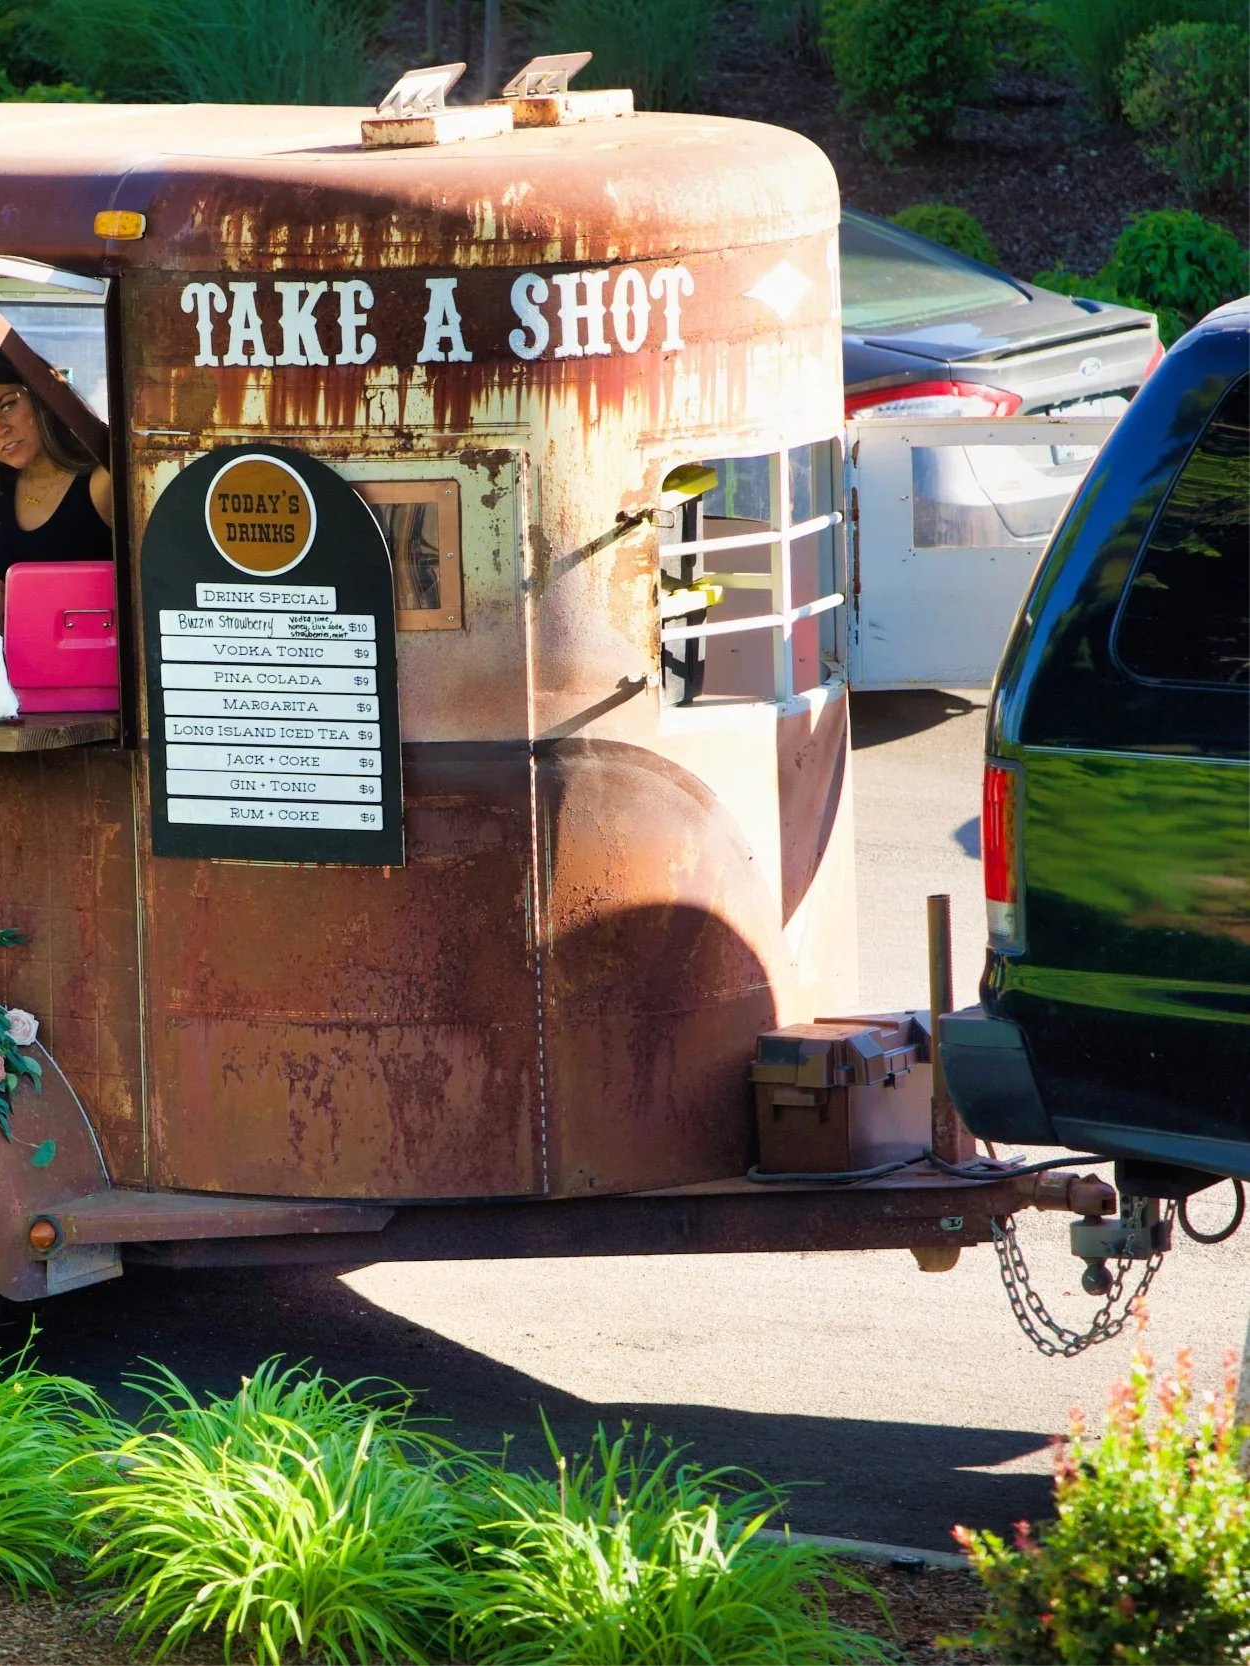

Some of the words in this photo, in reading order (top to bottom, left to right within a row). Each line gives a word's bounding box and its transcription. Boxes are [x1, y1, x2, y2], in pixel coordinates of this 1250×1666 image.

[180, 280, 377, 367] TAKE
[416, 277, 473, 363] A
[509, 267, 694, 361] SHOT
[218, 490, 301, 514] TODAY'S
[225, 522, 296, 543] DRINKS
[203, 590, 255, 603] DRINK
[259, 592, 328, 605] SPECIAL
[178, 614, 213, 629] Buzzin
[219, 615, 274, 638] Strawberry
[348, 623, 367, 632] $10
[213, 644, 272, 656] VODKA
[276, 646, 324, 658] TONIC
[354, 649, 369, 658] $9
[214, 672, 252, 683] PINA
[257, 674, 322, 685] COLADA
[354, 676, 368, 686] $9
[223, 699, 318, 711] MARGARITA
[356, 703, 371, 712] $9
[173, 724, 214, 735] LONG
[218, 726, 276, 738] ISLAND
[280, 728, 314, 739] ICED
[318, 729, 350, 740] TEA
[358, 731, 373, 740] $9
[227, 754, 264, 766] JACK
[279, 756, 320, 767] COKE
[359, 758, 374, 767] $9
[230, 780, 256, 790] GIN
[270, 781, 316, 792] TONIC
[359, 785, 374, 794] $9
[230, 808, 264, 819] RUM
[278, 810, 319, 821] COKE
[361, 813, 375, 822] $9
